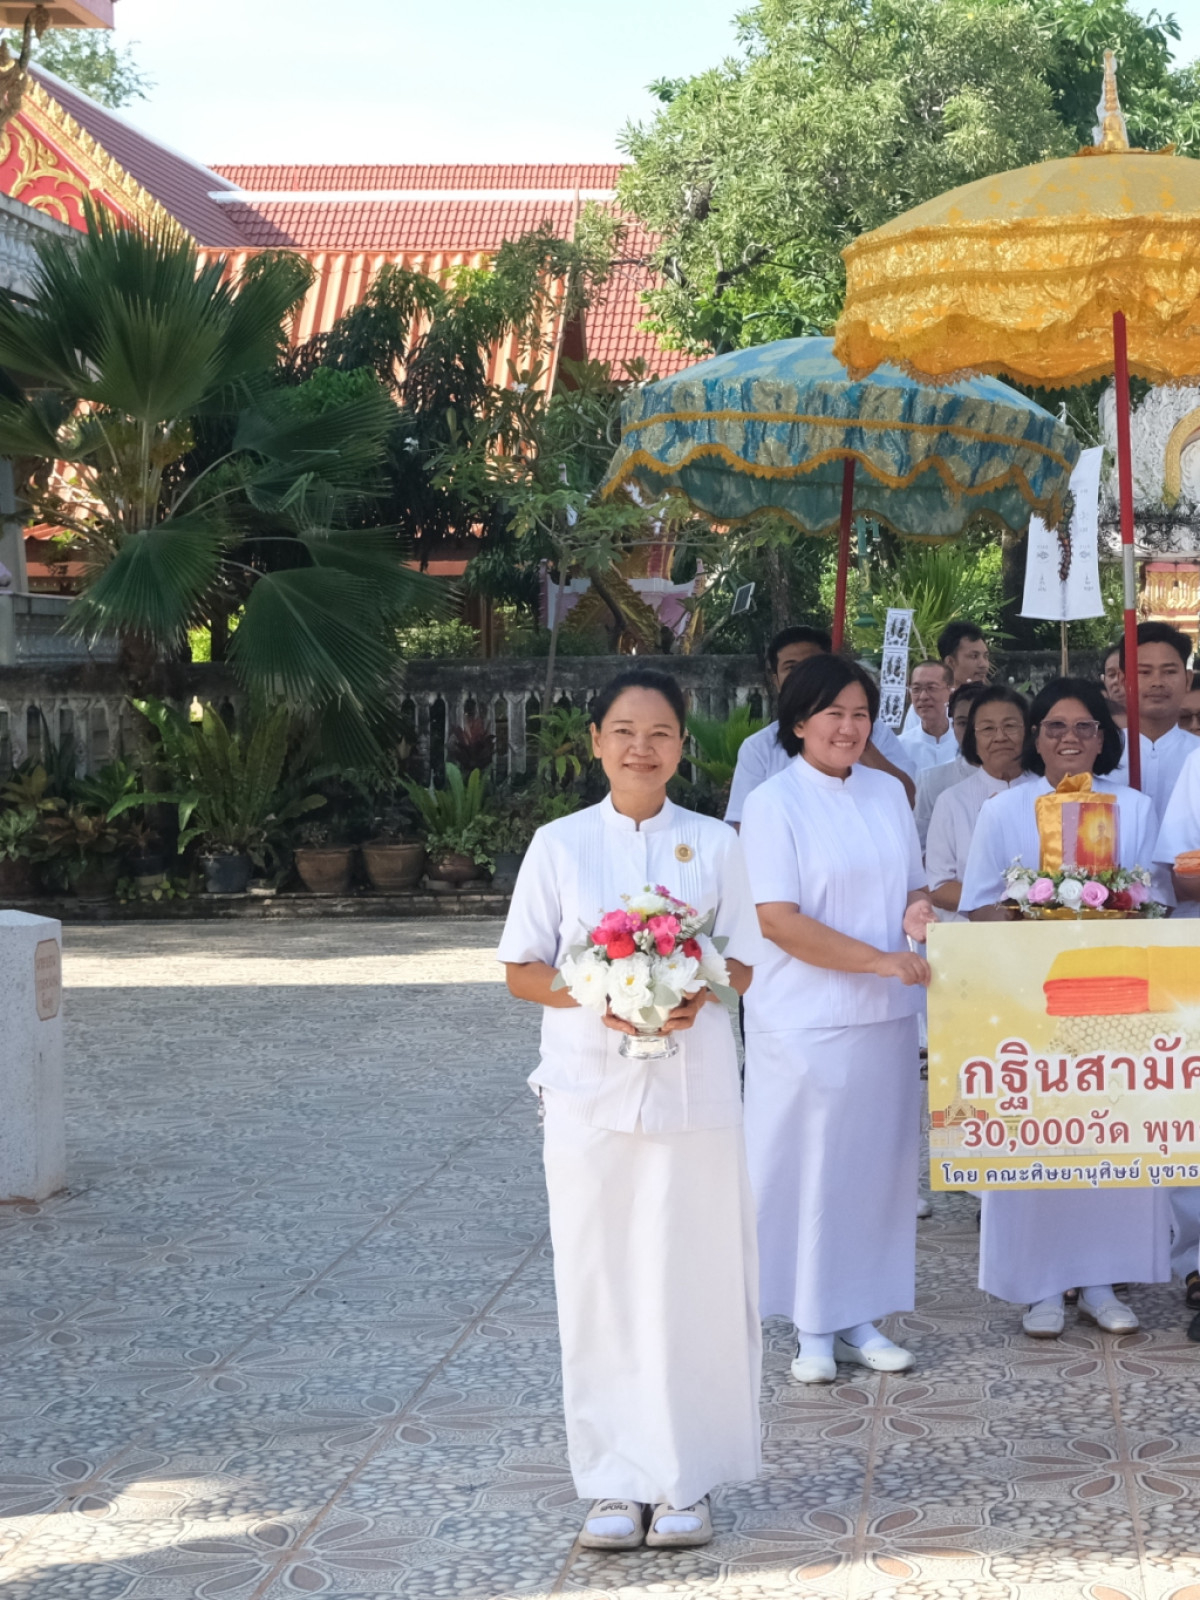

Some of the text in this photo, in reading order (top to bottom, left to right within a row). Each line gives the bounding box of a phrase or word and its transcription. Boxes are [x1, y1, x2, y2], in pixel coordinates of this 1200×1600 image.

[965, 1108, 1130, 1153] 30,000วัด
[942, 1162, 978, 1183] โดย
[985, 1158, 1140, 1186] คณะศิษยานุศิษย์
